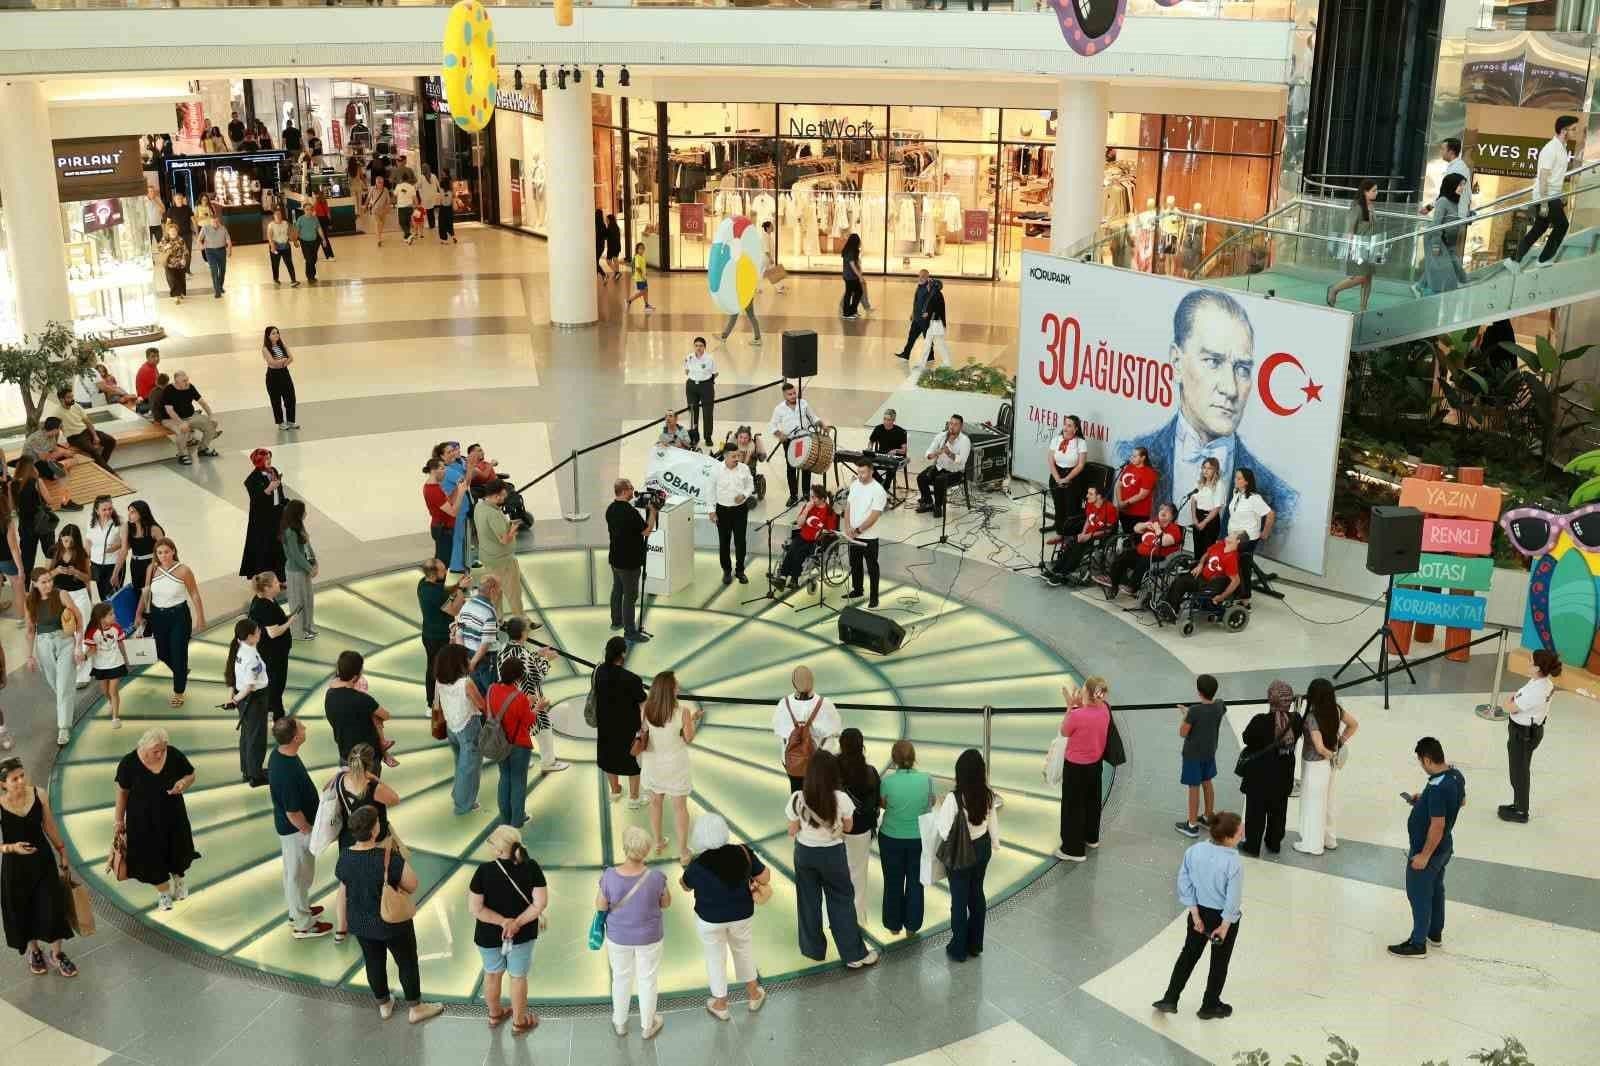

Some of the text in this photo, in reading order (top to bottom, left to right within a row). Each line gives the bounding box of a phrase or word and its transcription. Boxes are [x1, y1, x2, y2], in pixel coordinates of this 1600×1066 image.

[790, 117, 875, 139] NetWork
[57, 153, 120, 168] PIRLANT
[1477, 143, 1521, 159] YVES
[1029, 267, 1071, 285] KORUPARK
[1039, 312, 1174, 408] 30 AĞUSTOS
[663, 471, 701, 498] OBAM
[1426, 488, 1478, 510] YAZIN
[1430, 525, 1480, 545] RENKLİ
[647, 544, 665, 553] PARK
